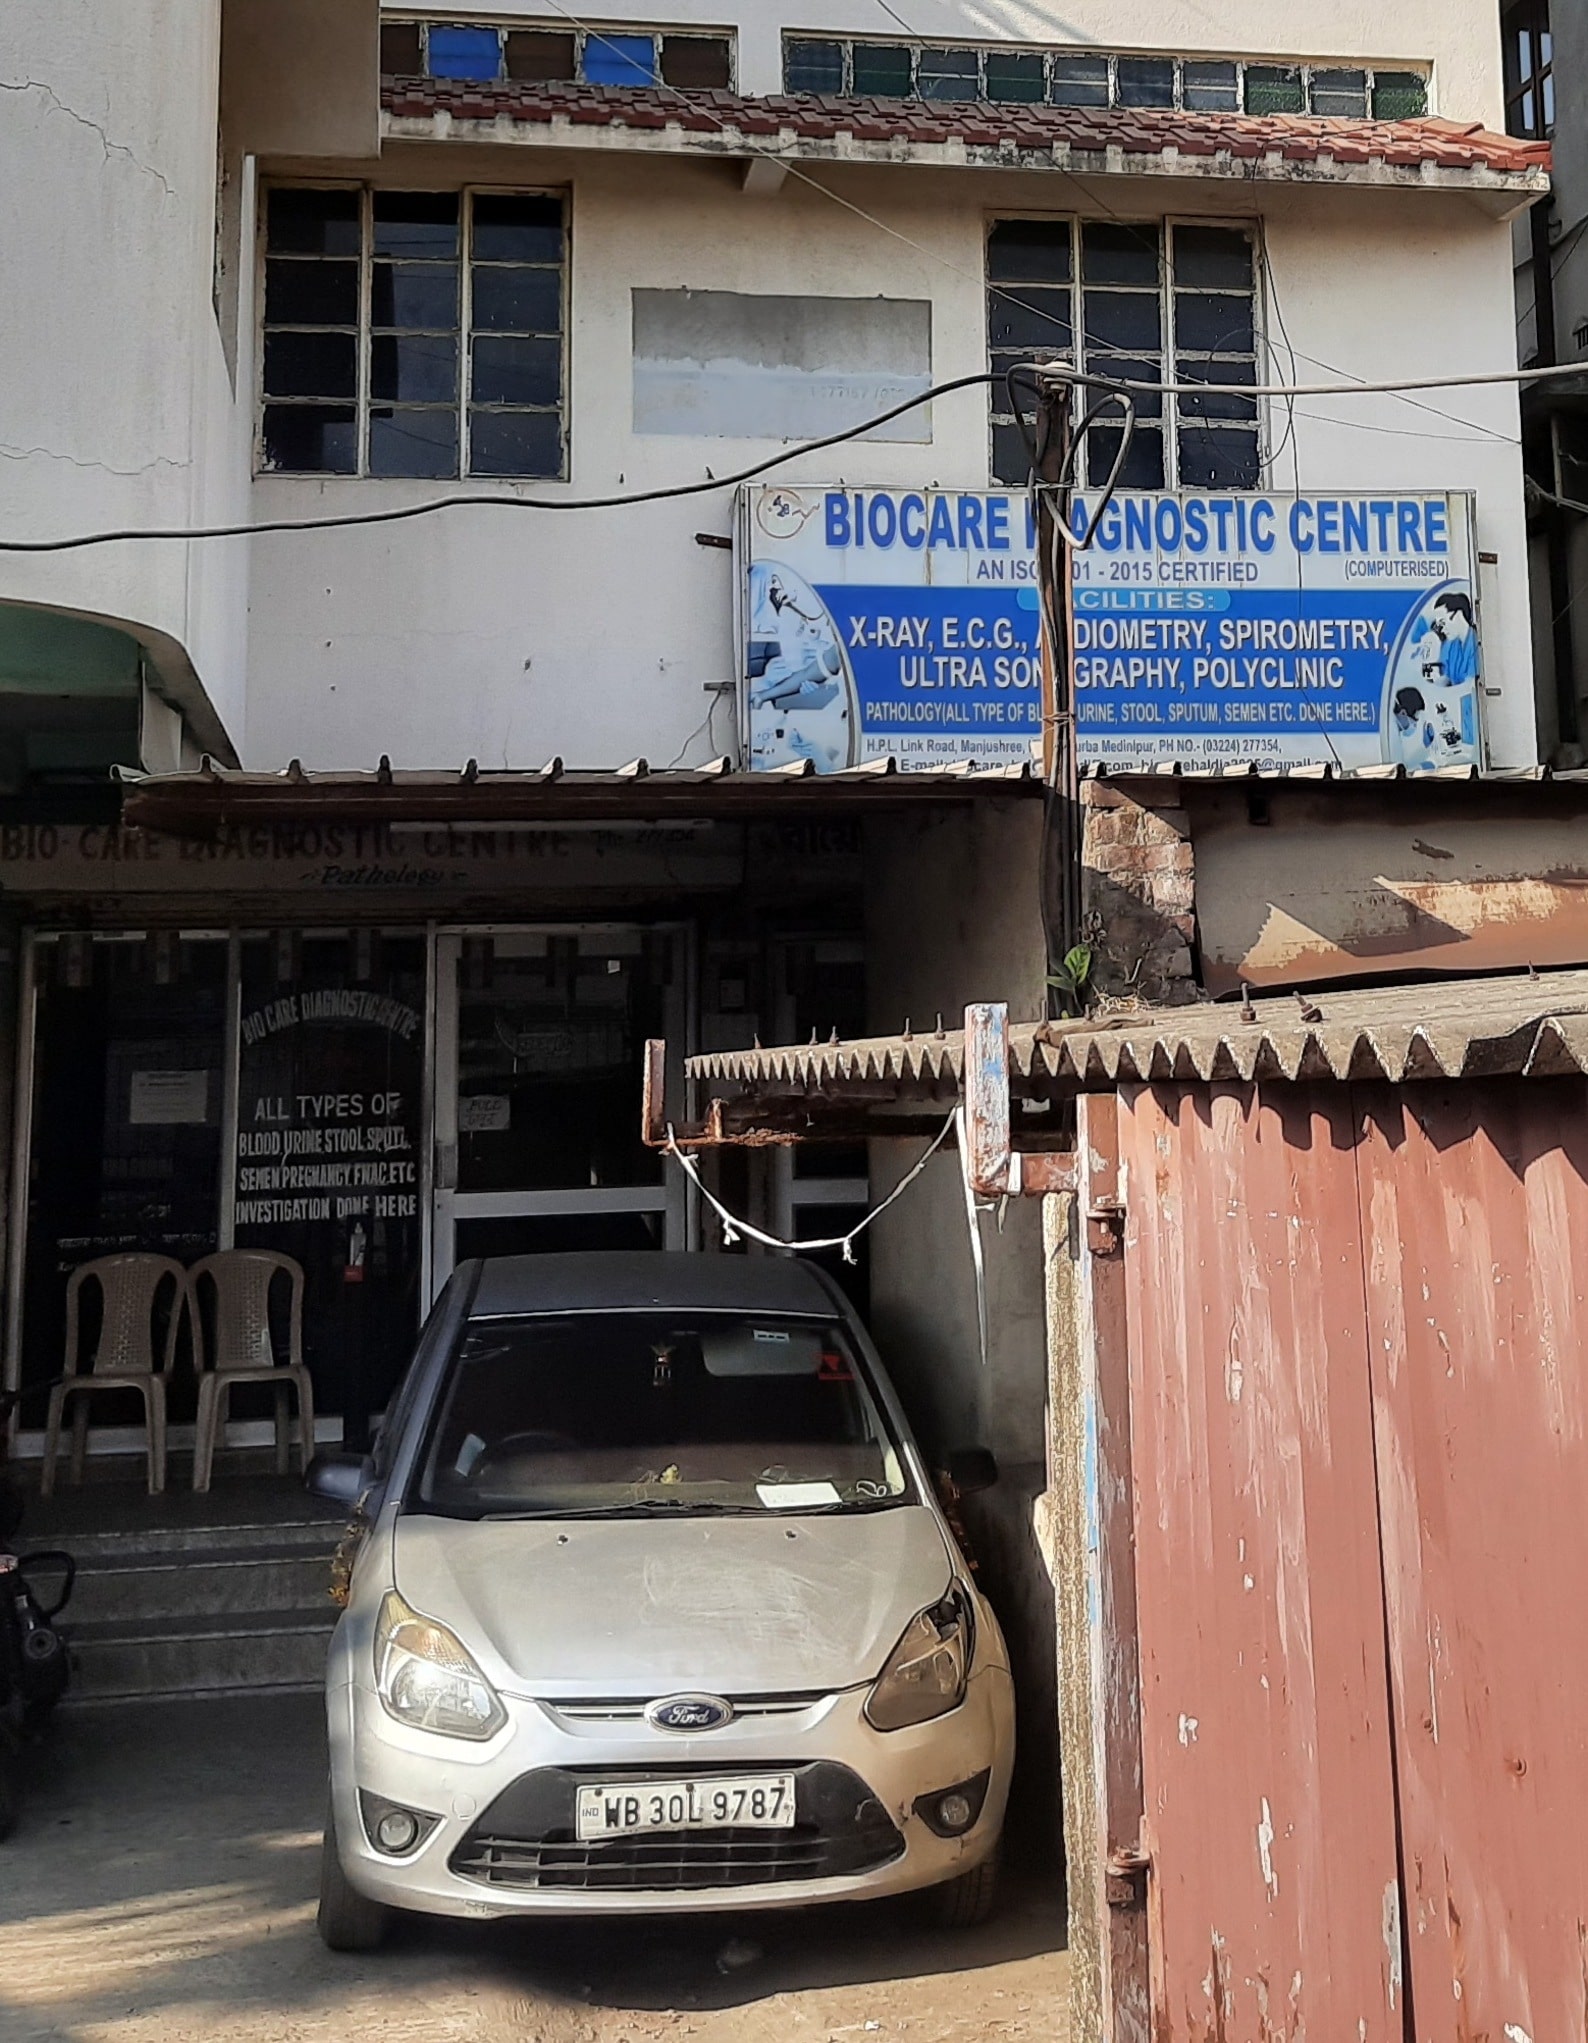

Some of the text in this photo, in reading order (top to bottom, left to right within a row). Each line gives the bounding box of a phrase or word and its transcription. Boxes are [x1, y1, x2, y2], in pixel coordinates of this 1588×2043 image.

[825, 493, 1448, 553] BIOCARE AGNOSTIC CENTRE
[977, 560, 1003, 579] AN
[1110, 561, 1152, 581] 2015
[1159, 562, 1258, 582] CERTIFIED
[1344, 560, 1449, 581] (COMPUTERISED)
[1073, 590, 1215, 610] CILITIES:
[849, 616, 1388, 655] X-RAY, E.C.G., DIOMETRY, SPIROMETRY,
[900, 656, 1344, 693] ULTRA SONGRAPHY, POLYCLINIC
[972, 703, 1004, 721] TYPE
[1007, 703, 1024, 721] OF
[1077, 703, 1118, 725] URINE,
[1121, 702, 1165, 724] STOOL,
[1168, 702, 1221, 724] SPUTUM,
[1224, 702, 1266, 722] SEMEN
[1269, 702, 1296, 722] ETC.
[1299, 703, 1332, 722] DONE
[901, 739, 923, 752] Link
[927, 739, 957, 754] Road,
[961, 739, 1025, 756] Manjushree,
[1159, 740, 1173, 752] PH
[1203, 739, 1240, 755] (03224)
[1243, 739, 1282, 754] 277354,
[264, 996, 300, 1032] CARE
[255, 1091, 401, 1121] ALL TYPES OF
[236, 1195, 417, 1224] INVESTIGATION DONE HERE
[668, 1705, 709, 1725] Ford
[604, 1796, 640, 1829] WB
[713, 1786, 786, 1822] 9787
